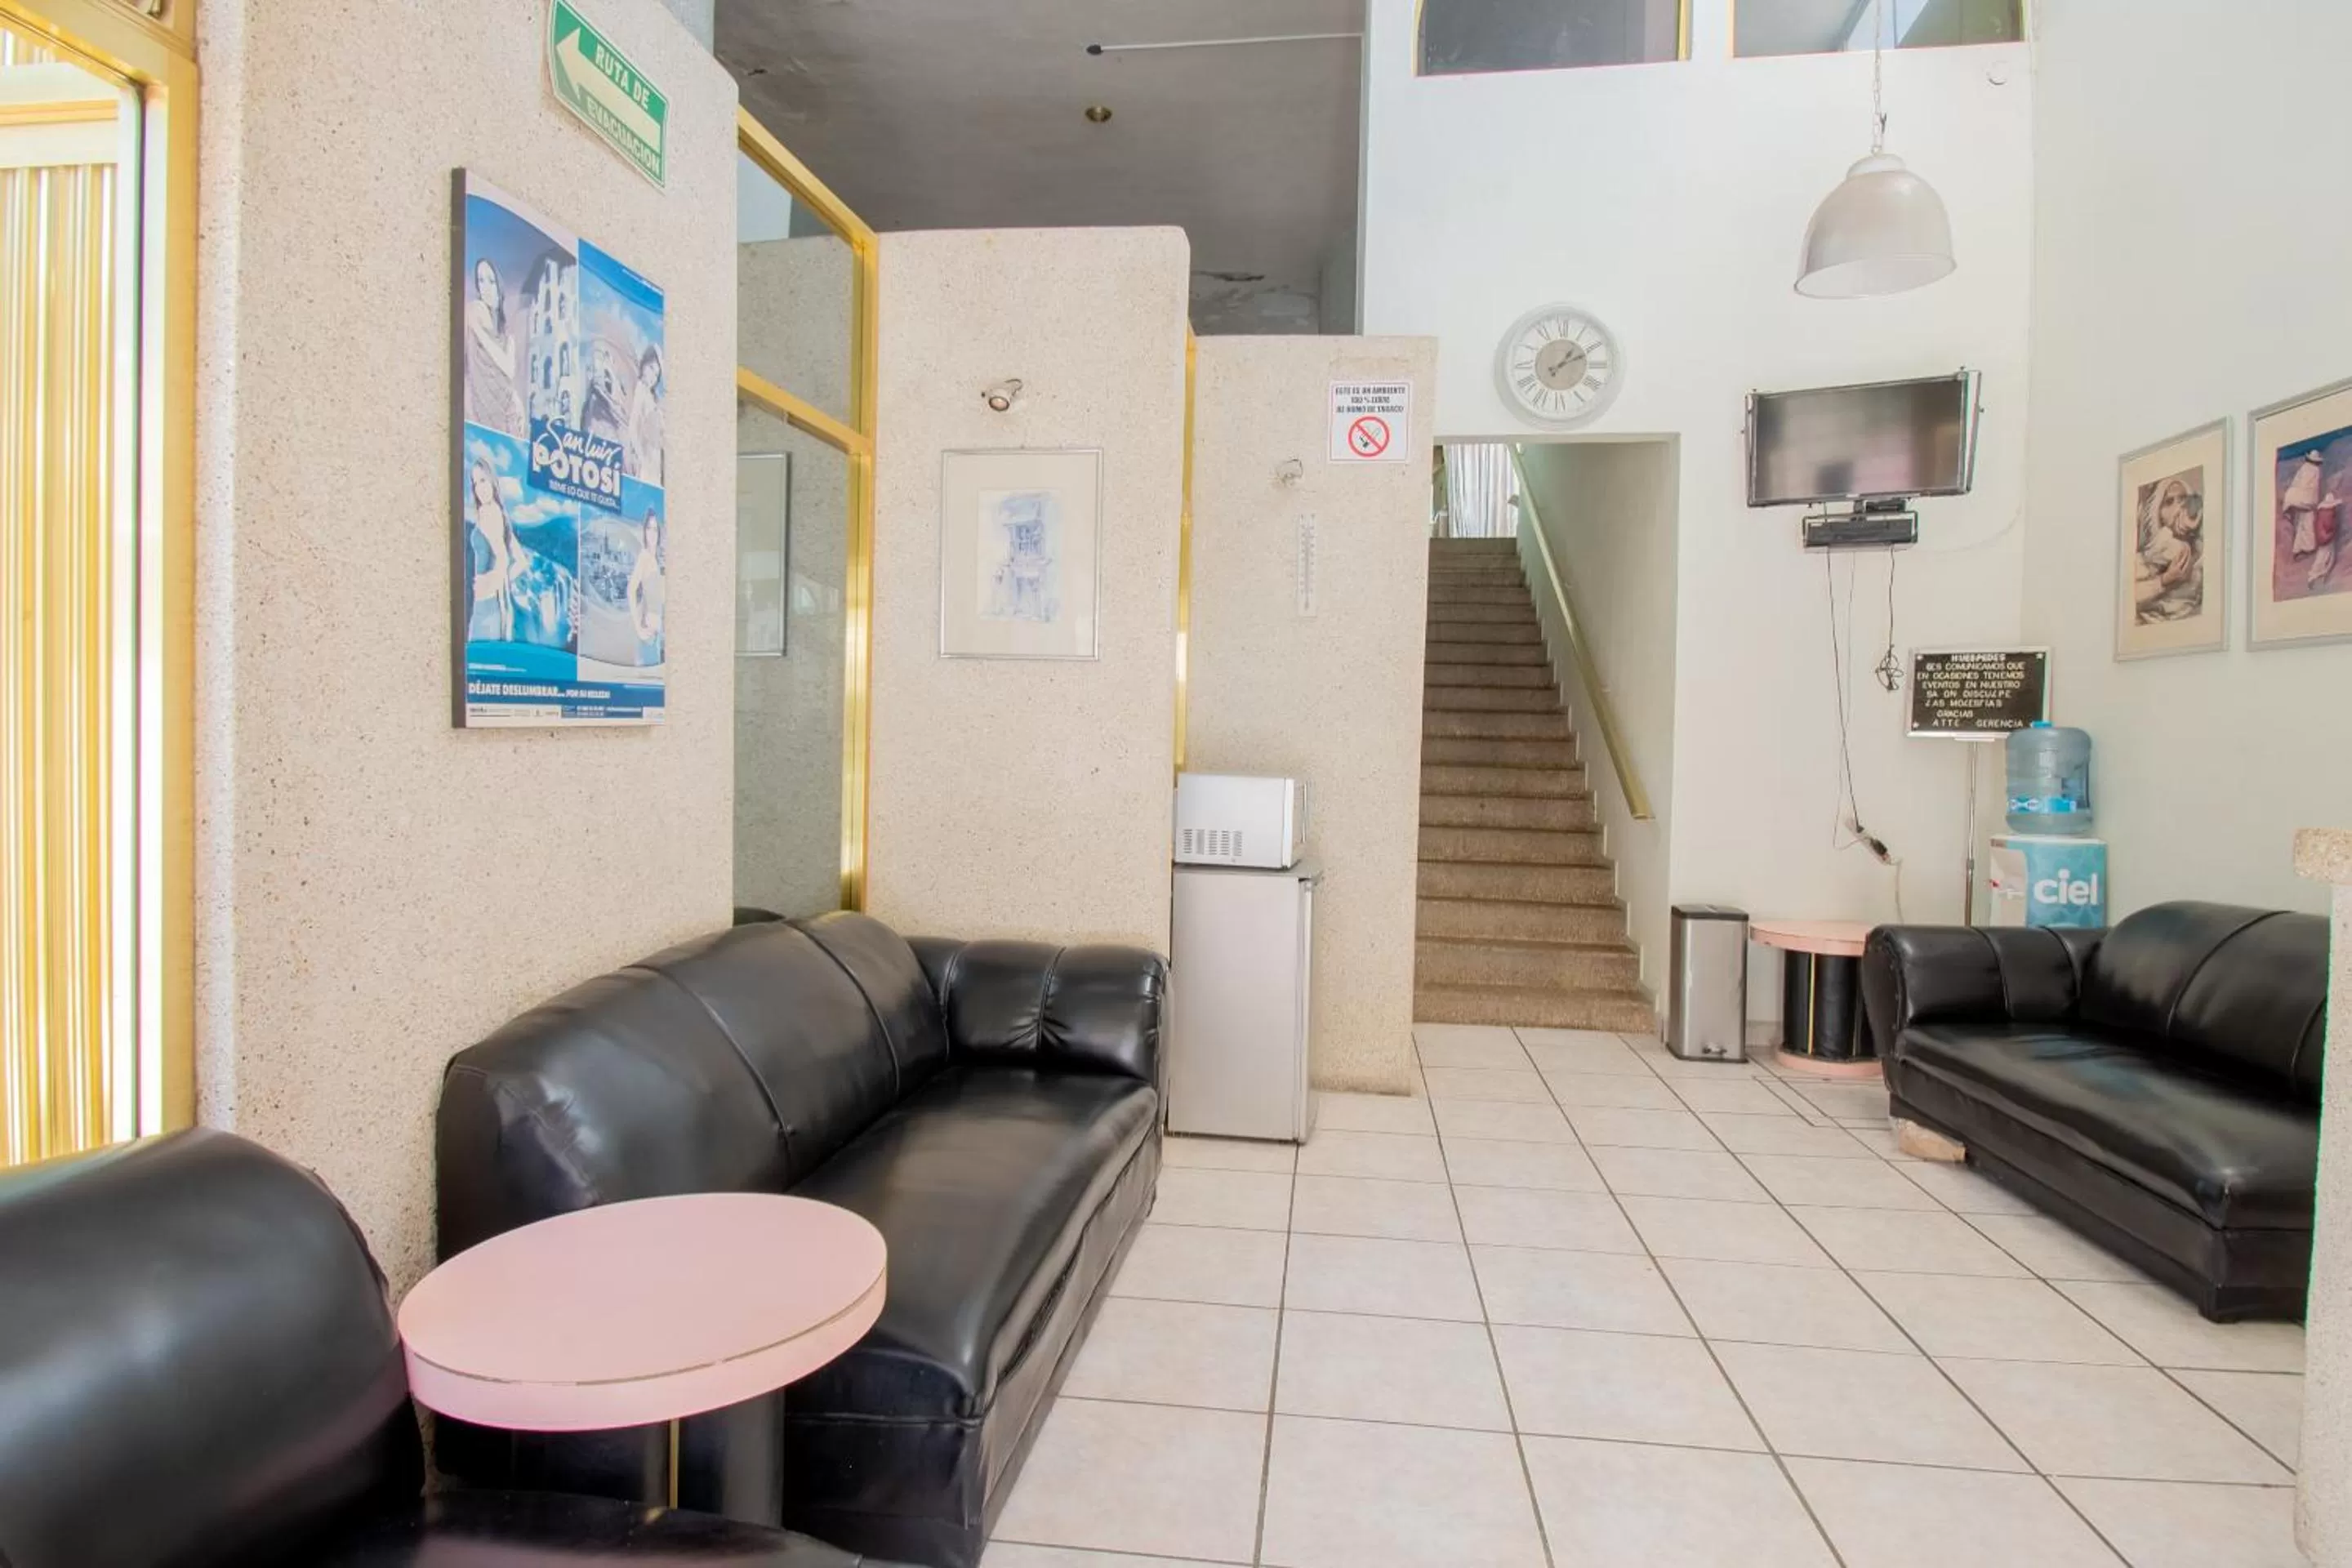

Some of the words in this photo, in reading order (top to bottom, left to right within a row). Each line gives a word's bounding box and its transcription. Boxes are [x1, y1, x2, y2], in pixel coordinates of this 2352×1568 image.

[595, 43, 630, 92] RUTA
[633, 82, 650, 109] DE
[537, 415, 584, 455] San
[585, 429, 621, 466] Luis
[532, 441, 621, 497] POTOSÍ
[1933, 671, 1979, 679] OCASIONES
[1983, 670, 2025, 679] TENEMOS
[1922, 680, 1960, 689] EVENTOS
[1965, 680, 1976, 688] EN
[1980, 680, 2020, 688] NUESTRO
[1936, 710, 1973, 718] GRACIAS
[1976, 718, 2023, 728] GERENCIA
